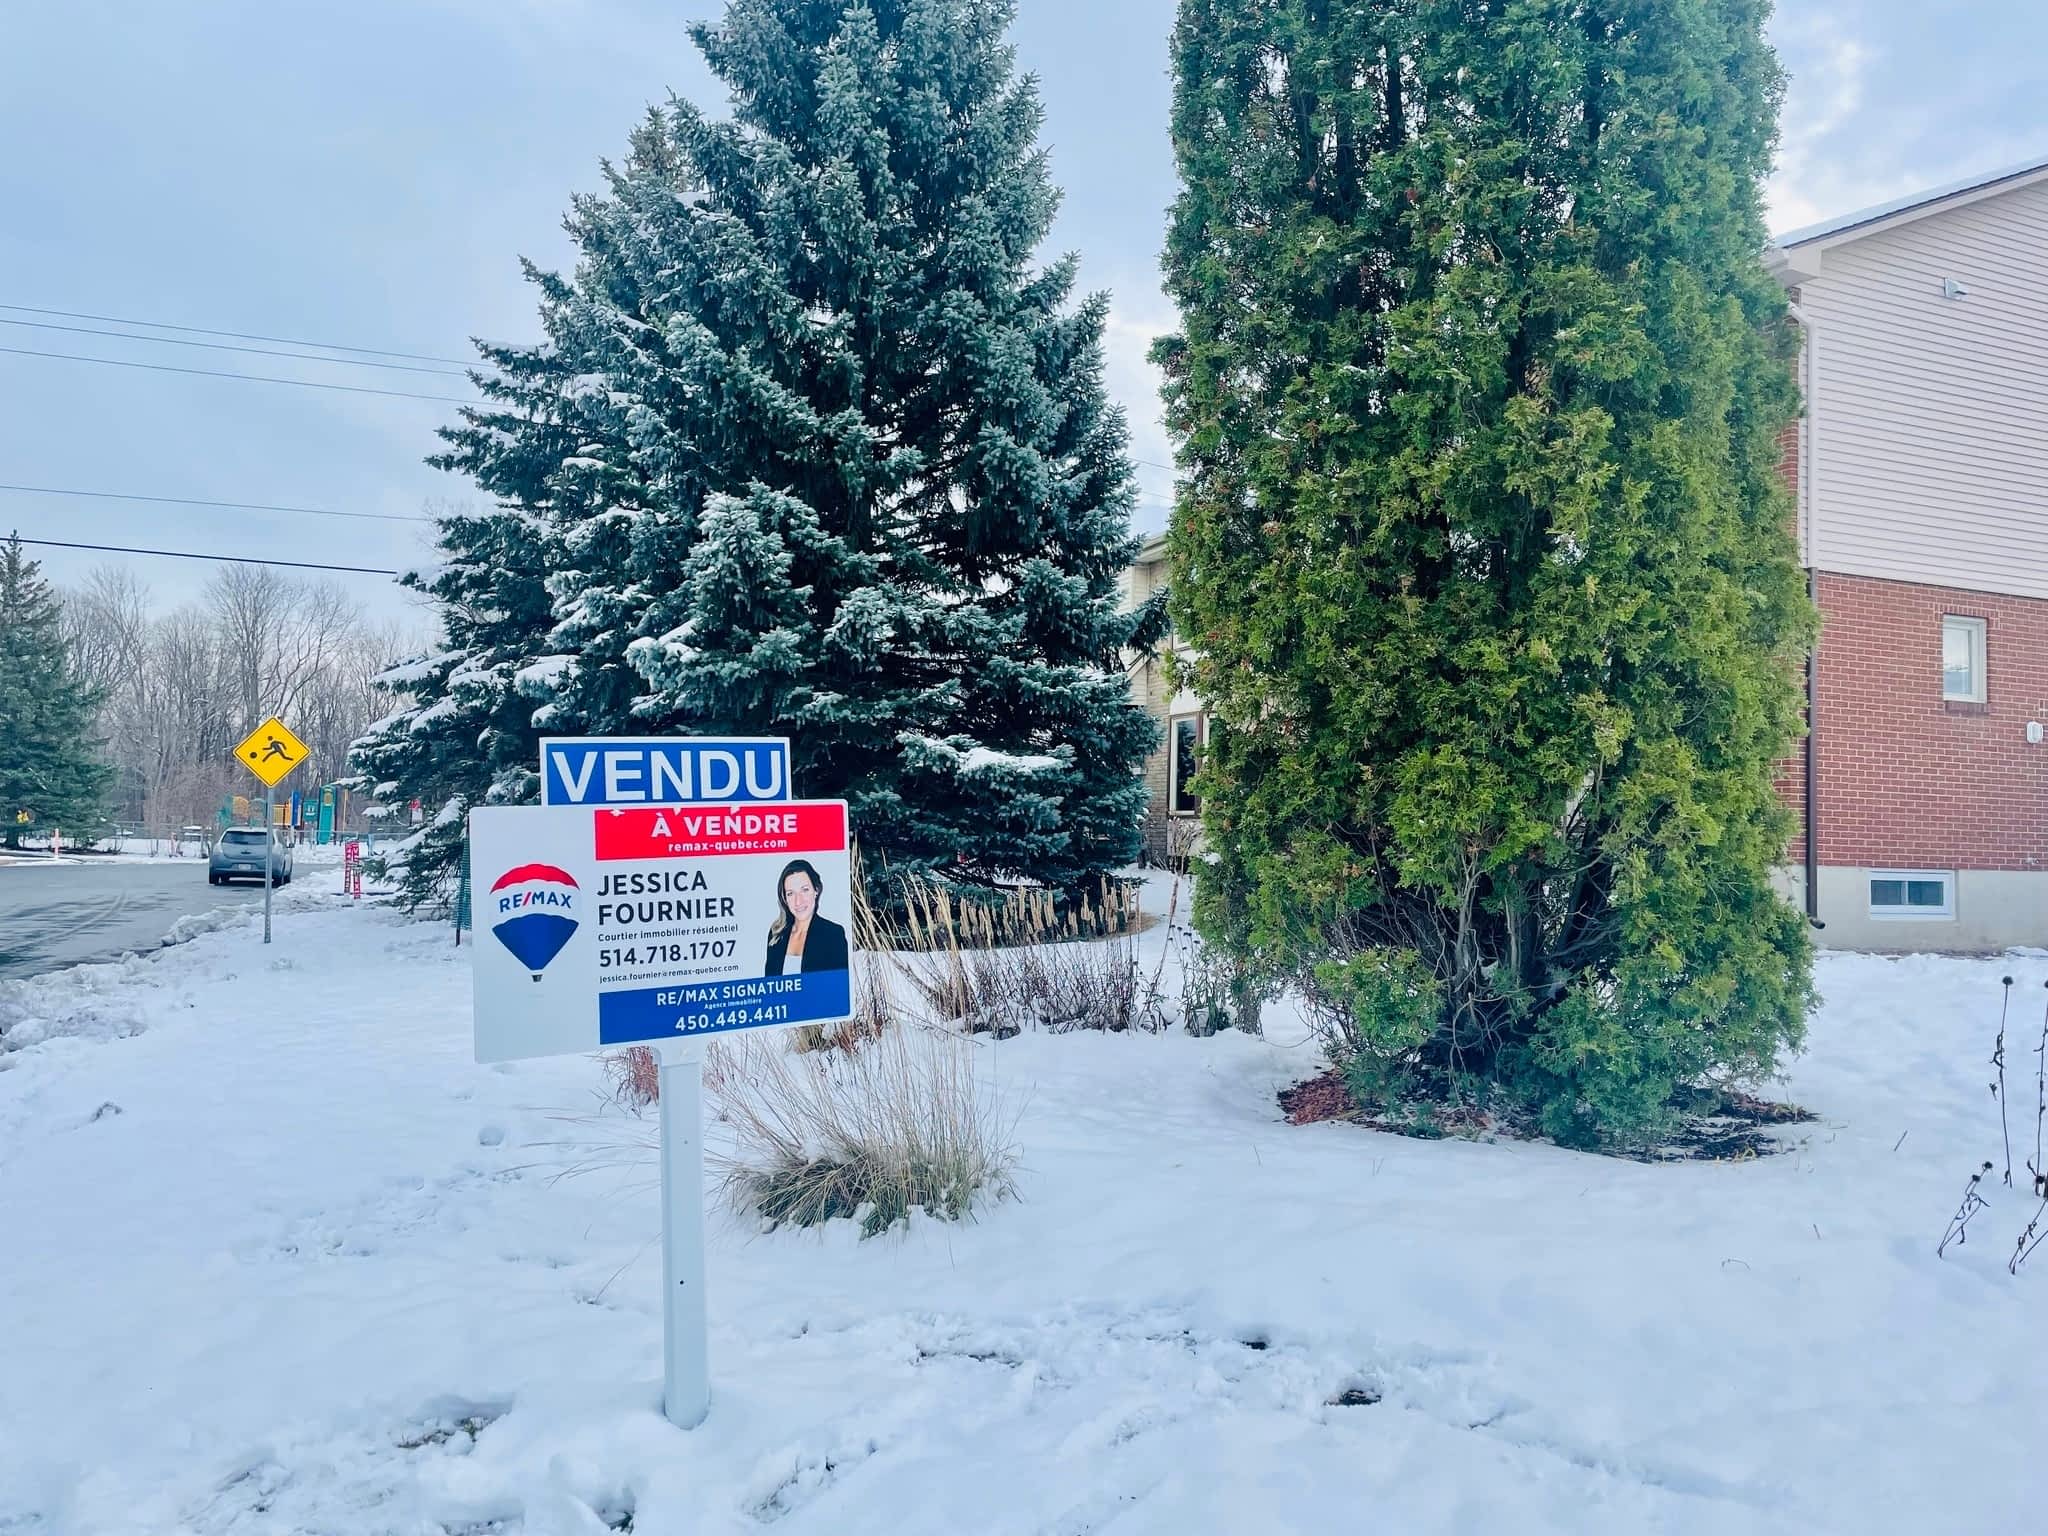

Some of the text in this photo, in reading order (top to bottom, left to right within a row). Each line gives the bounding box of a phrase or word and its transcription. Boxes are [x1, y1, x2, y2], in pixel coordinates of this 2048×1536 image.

[551, 750, 782, 802] VENDU
[651, 813, 798, 838] À VENDRE
[668, 838, 787, 852] remax-quebec.com
[597, 870, 708, 896] JESSICA
[499, 891, 572, 913] RE/MAX
[599, 897, 735, 925] FOURNIER
[598, 924, 738, 942] Courtier immobilier résidentiel
[600, 940, 736, 967] 514.718.1707
[599, 964, 739, 984] jessica.fournier@remax-quebec.com
[657, 979, 802, 1006] RE/MAX SIGNATURE
[675, 1005, 788, 1031] 450.449.4411
